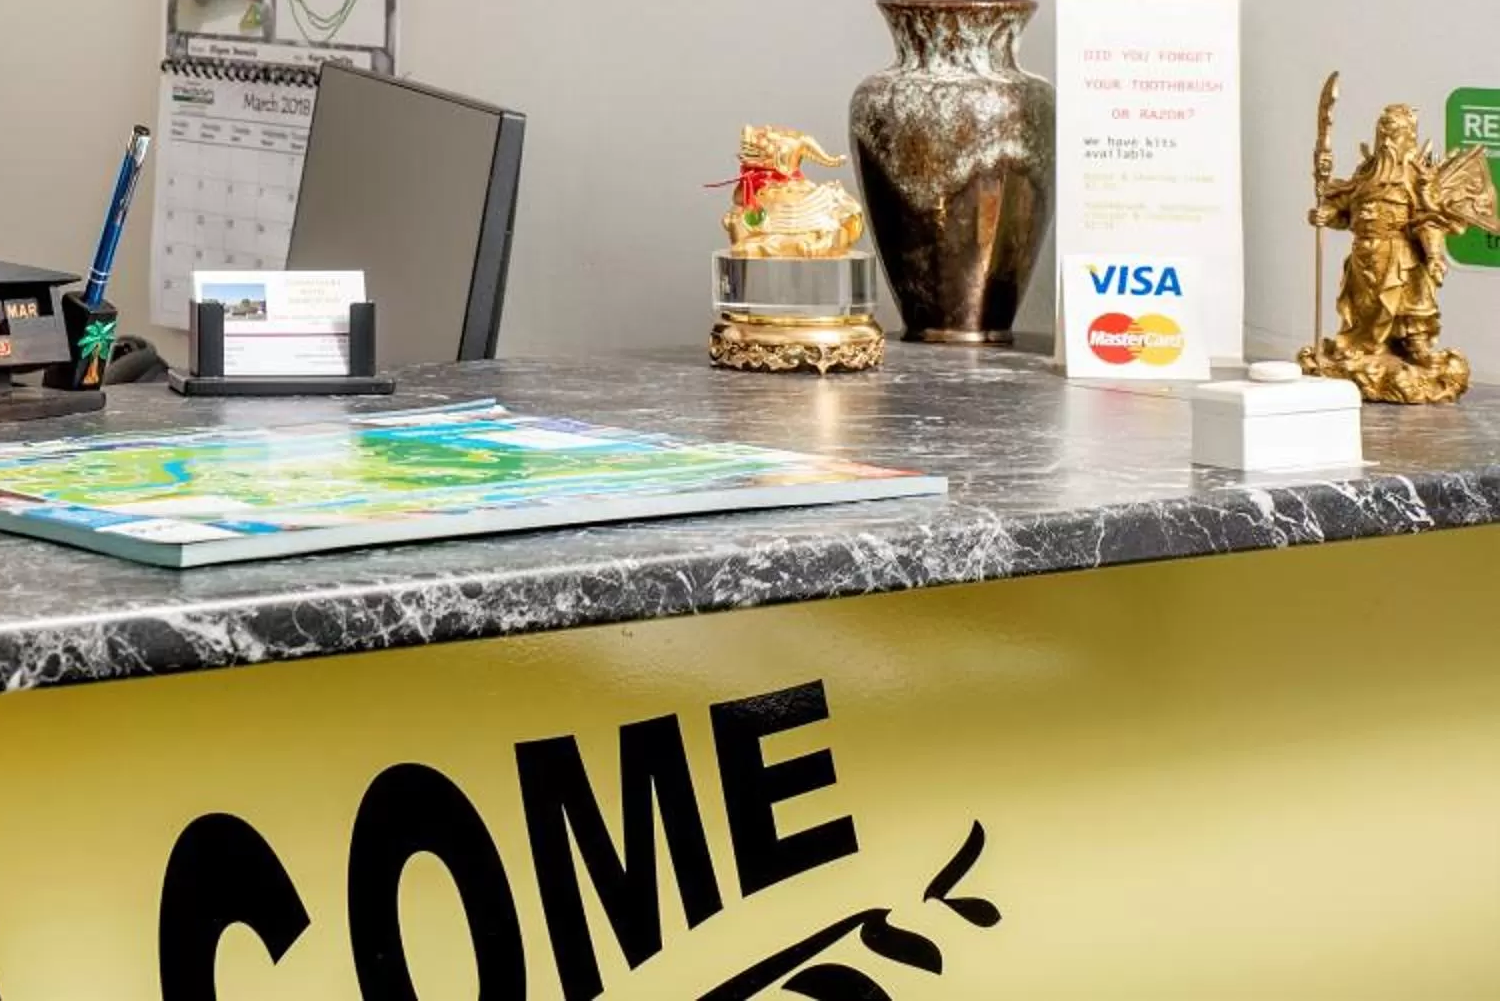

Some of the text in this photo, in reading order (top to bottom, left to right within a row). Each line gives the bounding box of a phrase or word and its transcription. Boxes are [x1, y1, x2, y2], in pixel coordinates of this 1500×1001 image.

[1083, 49, 1214, 64] DID YOU FORGET
[1083, 78, 1224, 93] YOUR TOOTHBRUSH
[243, 92, 311, 117] March 2018
[1110, 108, 1195, 120] OR RAZOR?
[1107, 136, 1138, 148] have
[1145, 137, 1177, 148] kits
[1084, 148, 1154, 160] available
[1086, 264, 1184, 297] VISA
[6, 303, 37, 318] MAR
[1091, 330, 1184, 348] MasterCard
